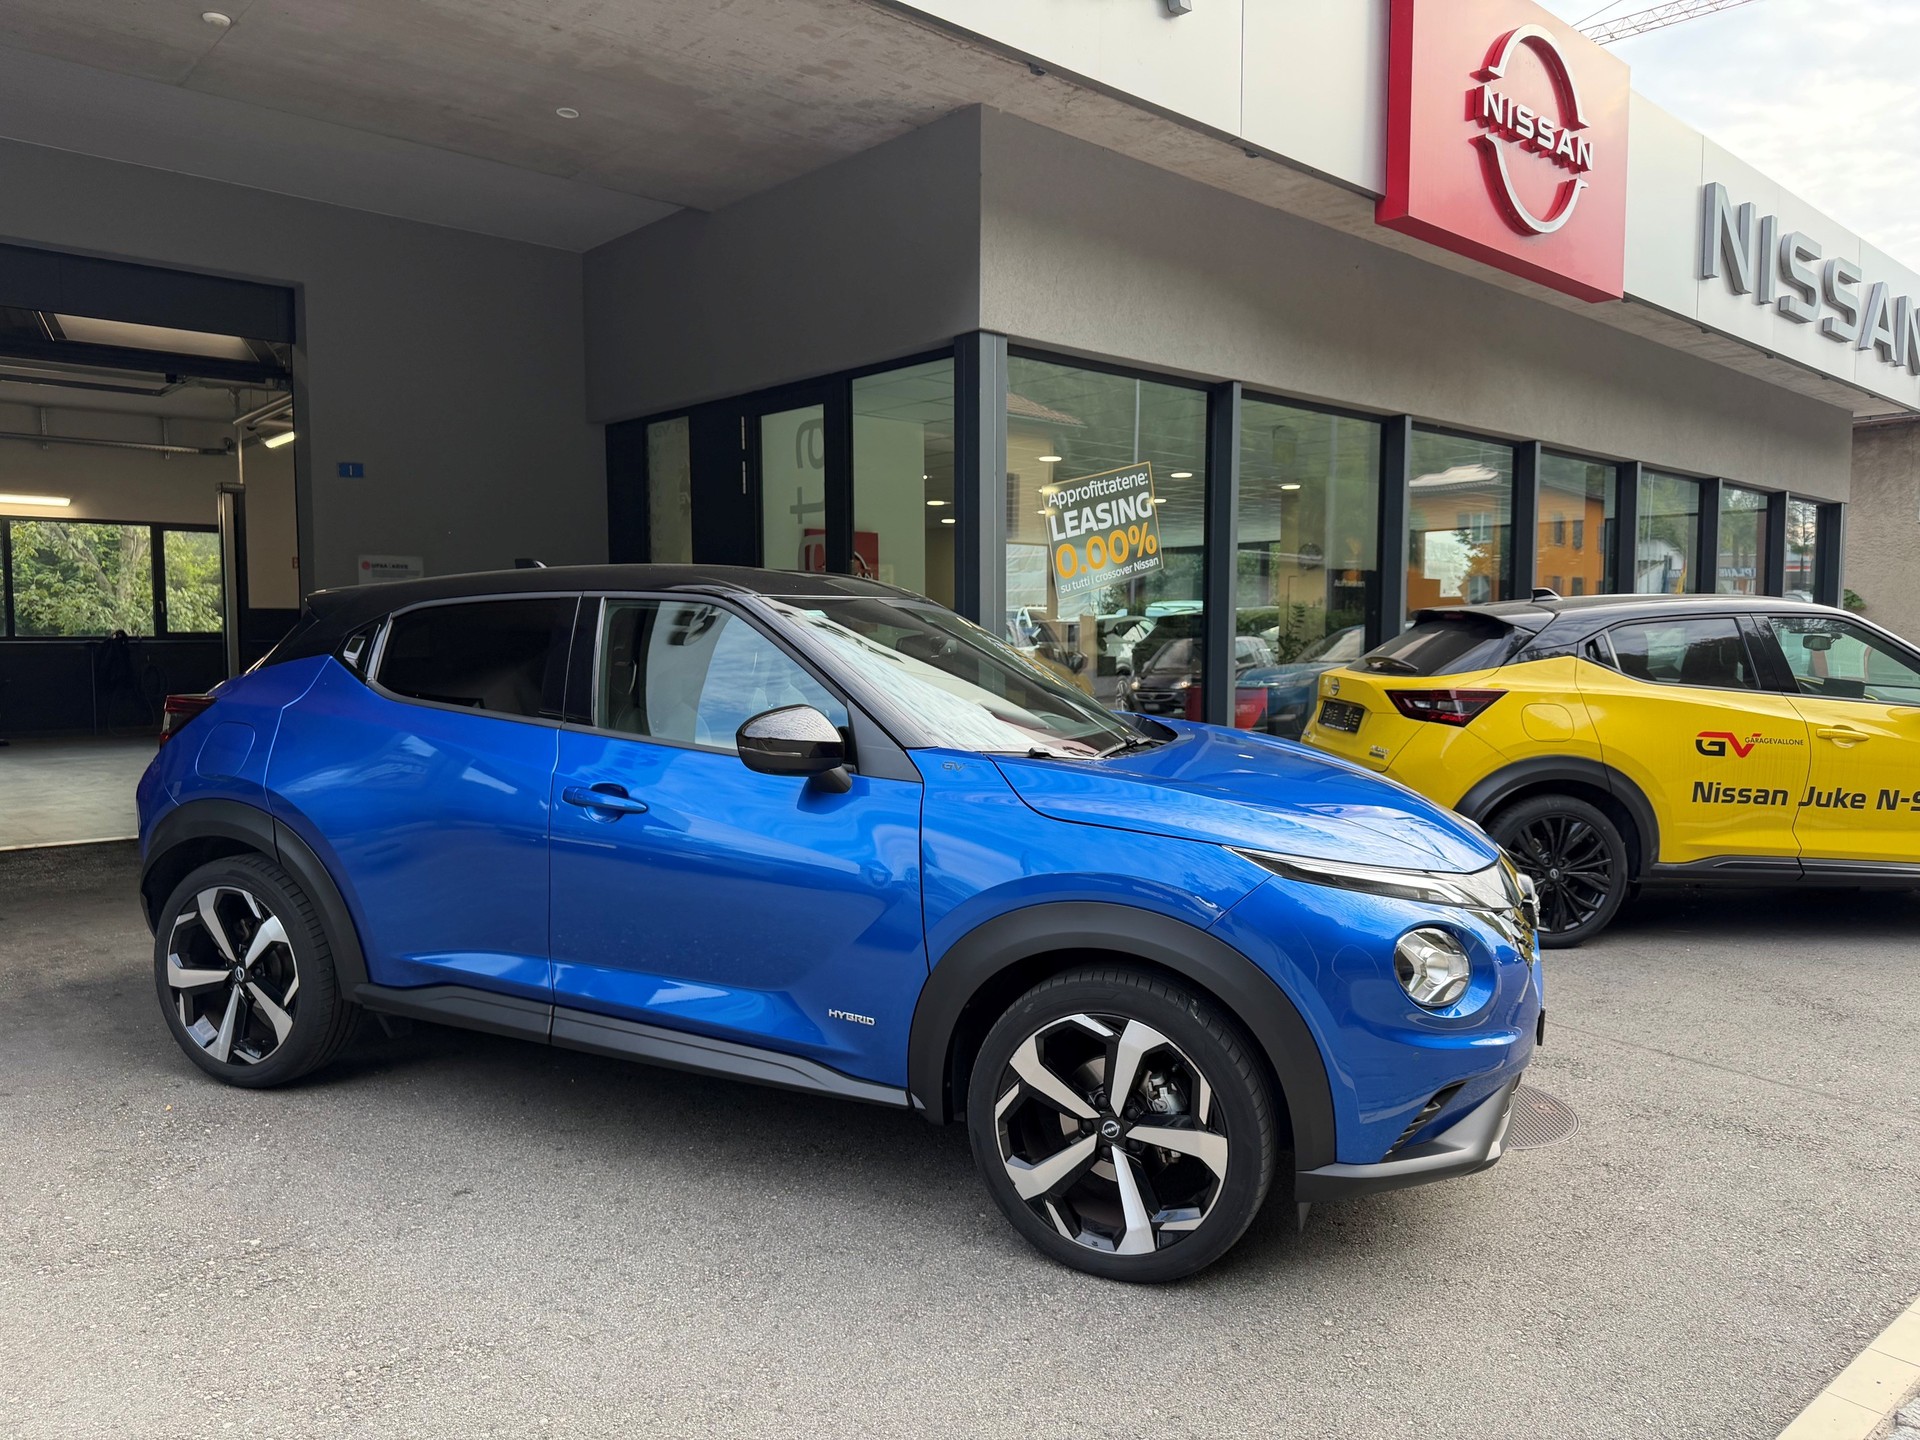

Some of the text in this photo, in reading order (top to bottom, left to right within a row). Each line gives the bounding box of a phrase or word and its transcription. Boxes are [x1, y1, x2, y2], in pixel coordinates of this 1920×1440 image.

[1481, 84, 1593, 172] NISSAN
[1702, 182, 1920, 376] NISSAN
[1048, 472, 1149, 509] Approfittatene:
[1050, 491, 1153, 541] LEASING
[1056, 522, 1157, 579] 0.00%
[1060, 584, 1071, 594] su
[1072, 575, 1090, 590] tutti
[1095, 564, 1134, 583] crossover
[1133, 557, 1159, 571] Nissan
[1696, 731, 1804, 758] GV GARAGEVALLONE
[1692, 781, 1789, 806] Nissan
[1798, 786, 1867, 810] Juke
[828, 1008, 876, 1026] HYBRID
